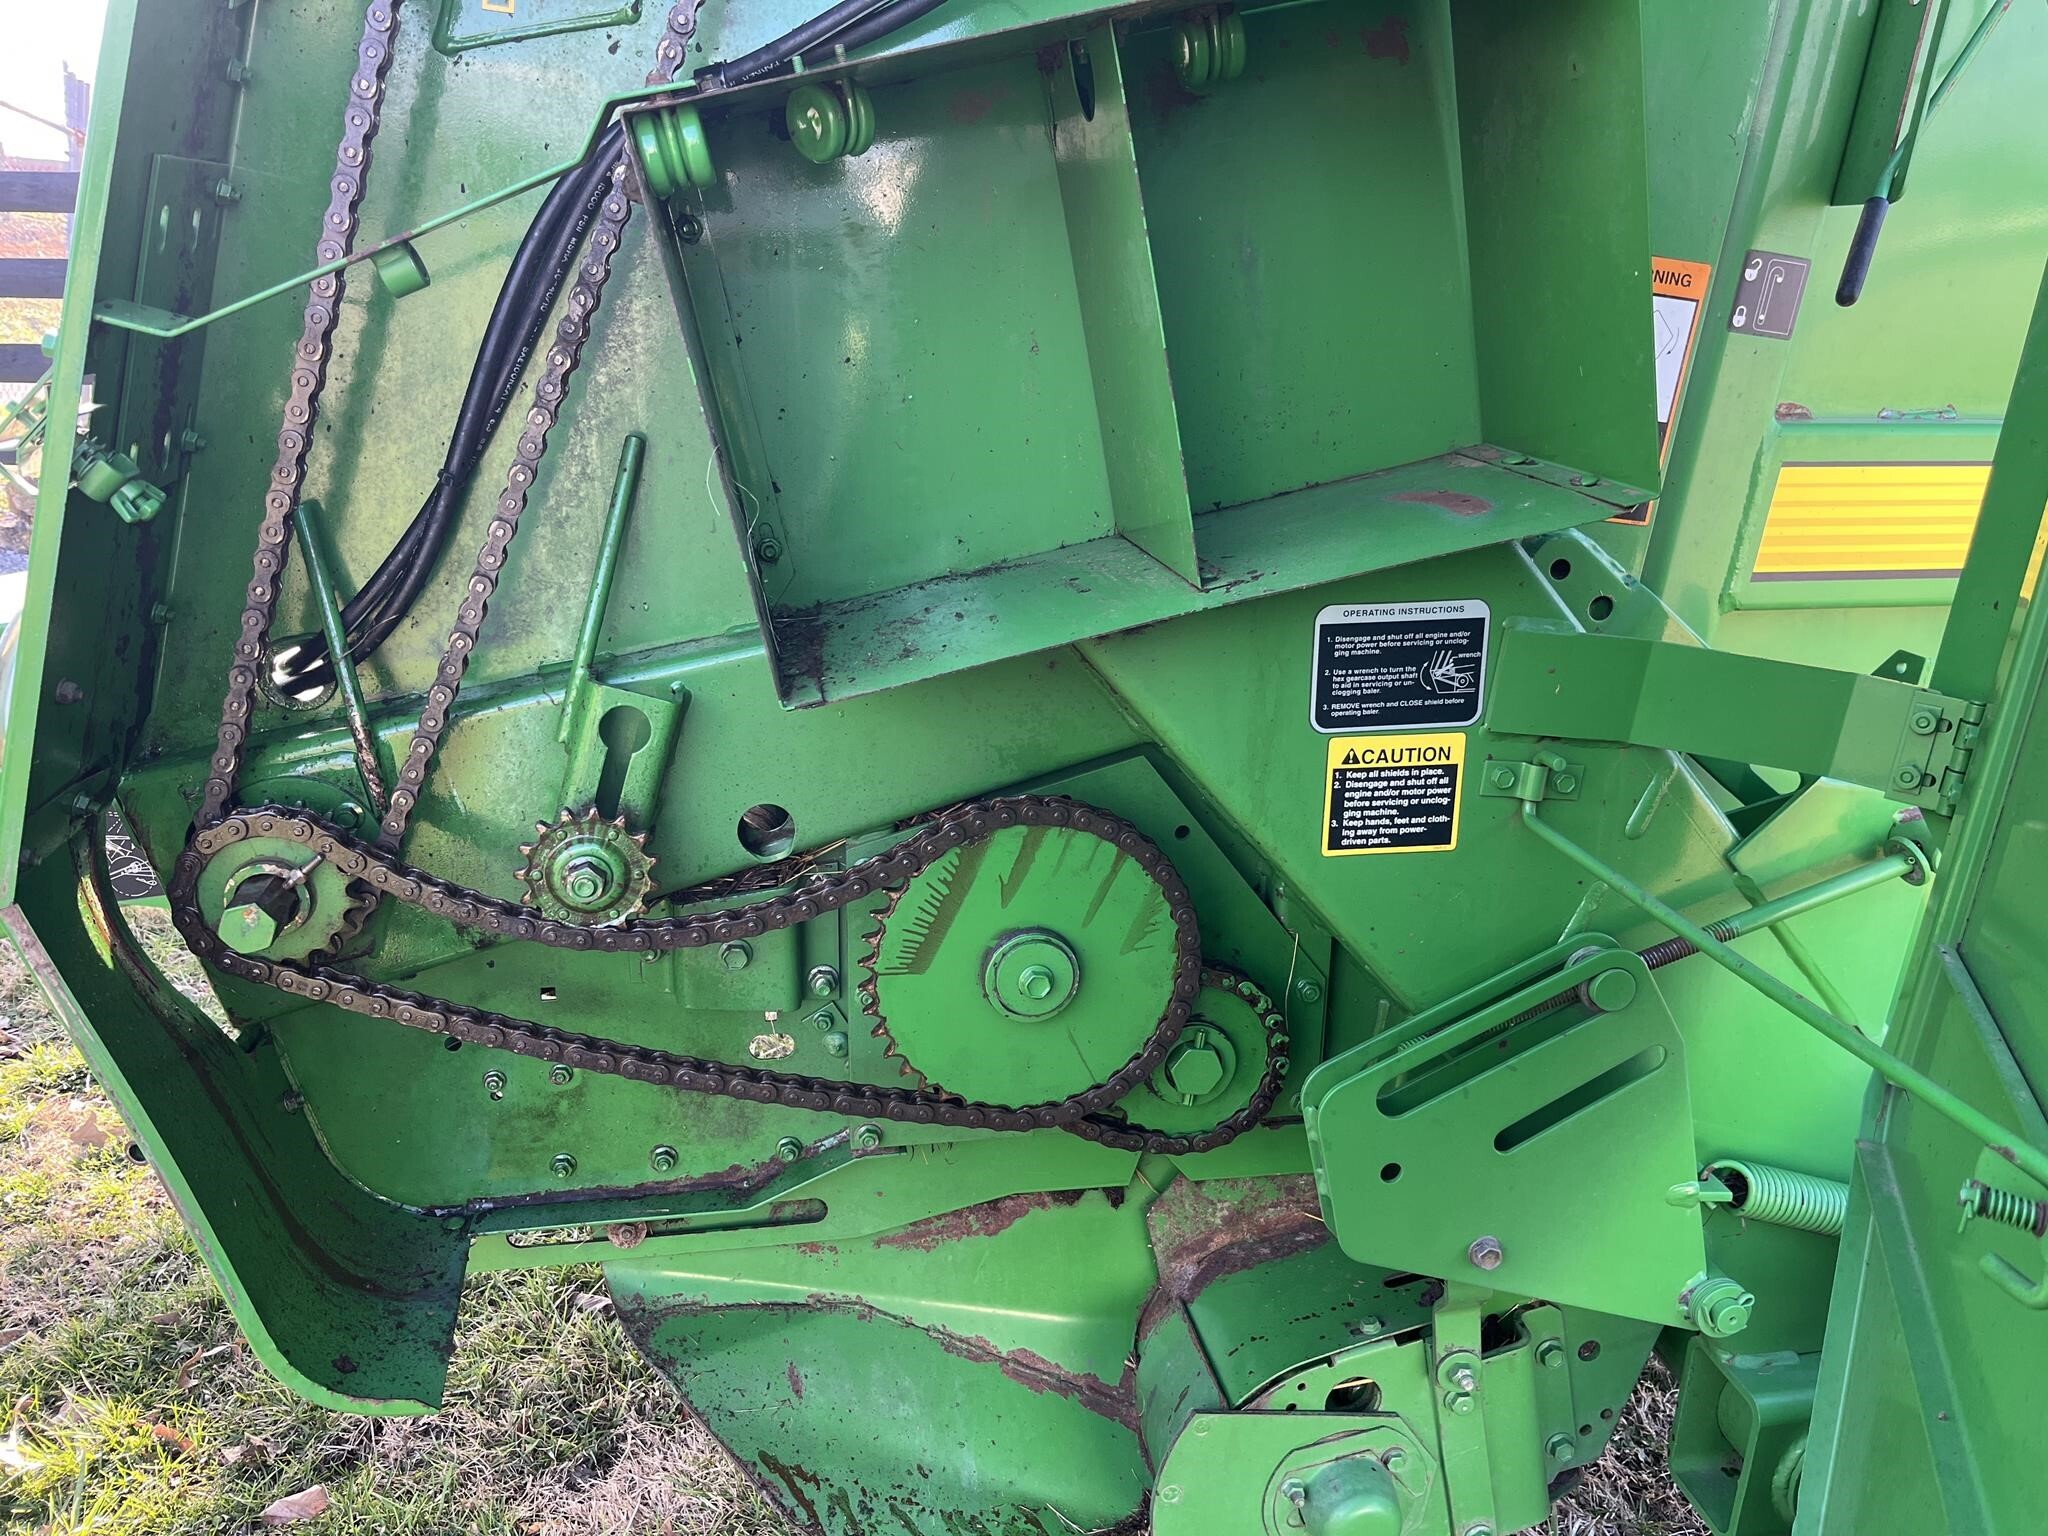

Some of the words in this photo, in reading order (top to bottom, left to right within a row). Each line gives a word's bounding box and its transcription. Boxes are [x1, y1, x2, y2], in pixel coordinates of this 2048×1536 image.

[1652, 270, 1692, 287] NING
[1343, 608, 1395, 617] OPERATING
[1398, 605, 1465, 615] INSTRUCTIONS
[1335, 635, 1371, 644] Disengage
[1402, 639, 1434, 648] servicing
[1378, 674, 1400, 682] output
[1362, 746, 1450, 764] CAUTION
[1346, 771, 1367, 780] Keep
[1420, 768, 1444, 776] place.
[1346, 780, 1388, 789] Disengage
[1344, 790, 1372, 799] engine
[1427, 787, 1451, 796] power
[1372, 798, 1409, 806] servicing
[1421, 797, 1450, 805] unclog-
[1343, 810, 1361, 818] ging
[1343, 819, 1363, 828] Keep
[1365, 817, 1392, 826] hands,
[1400, 827, 1427, 835] power-
[1368, 837, 1391, 845] parts.
